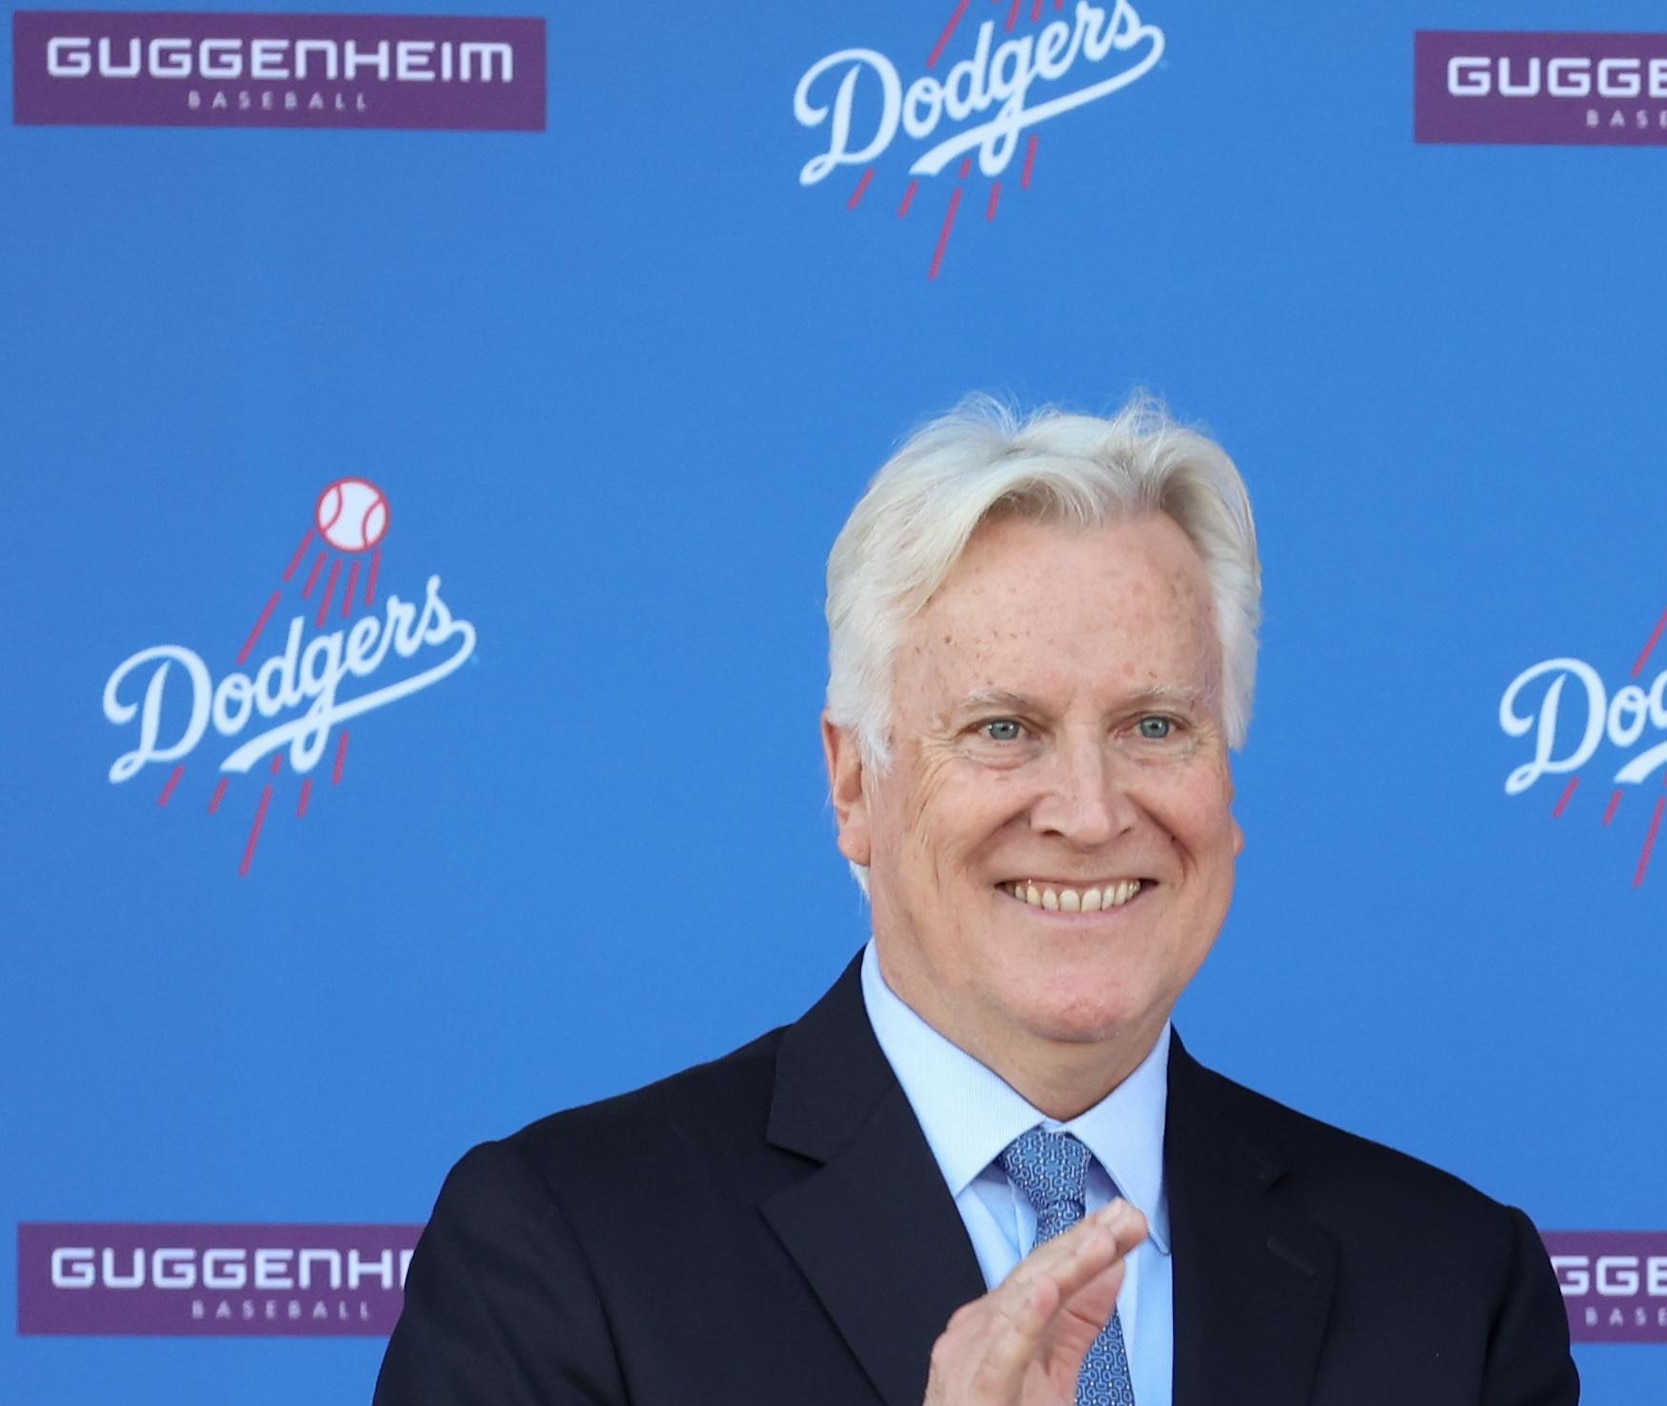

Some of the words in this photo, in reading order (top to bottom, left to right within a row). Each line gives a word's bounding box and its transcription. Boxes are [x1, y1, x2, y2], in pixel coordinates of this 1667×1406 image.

[46, 36, 514, 83] GUGGENHEIM
[187, 89, 368, 112] BASEBALL
[793, 0, 1166, 186] Dodgers
[102, 574, 477, 784] Dodgers
[50, 1246, 414, 1290] GUGGENH
[191, 1299, 371, 1321] BASEBALL
